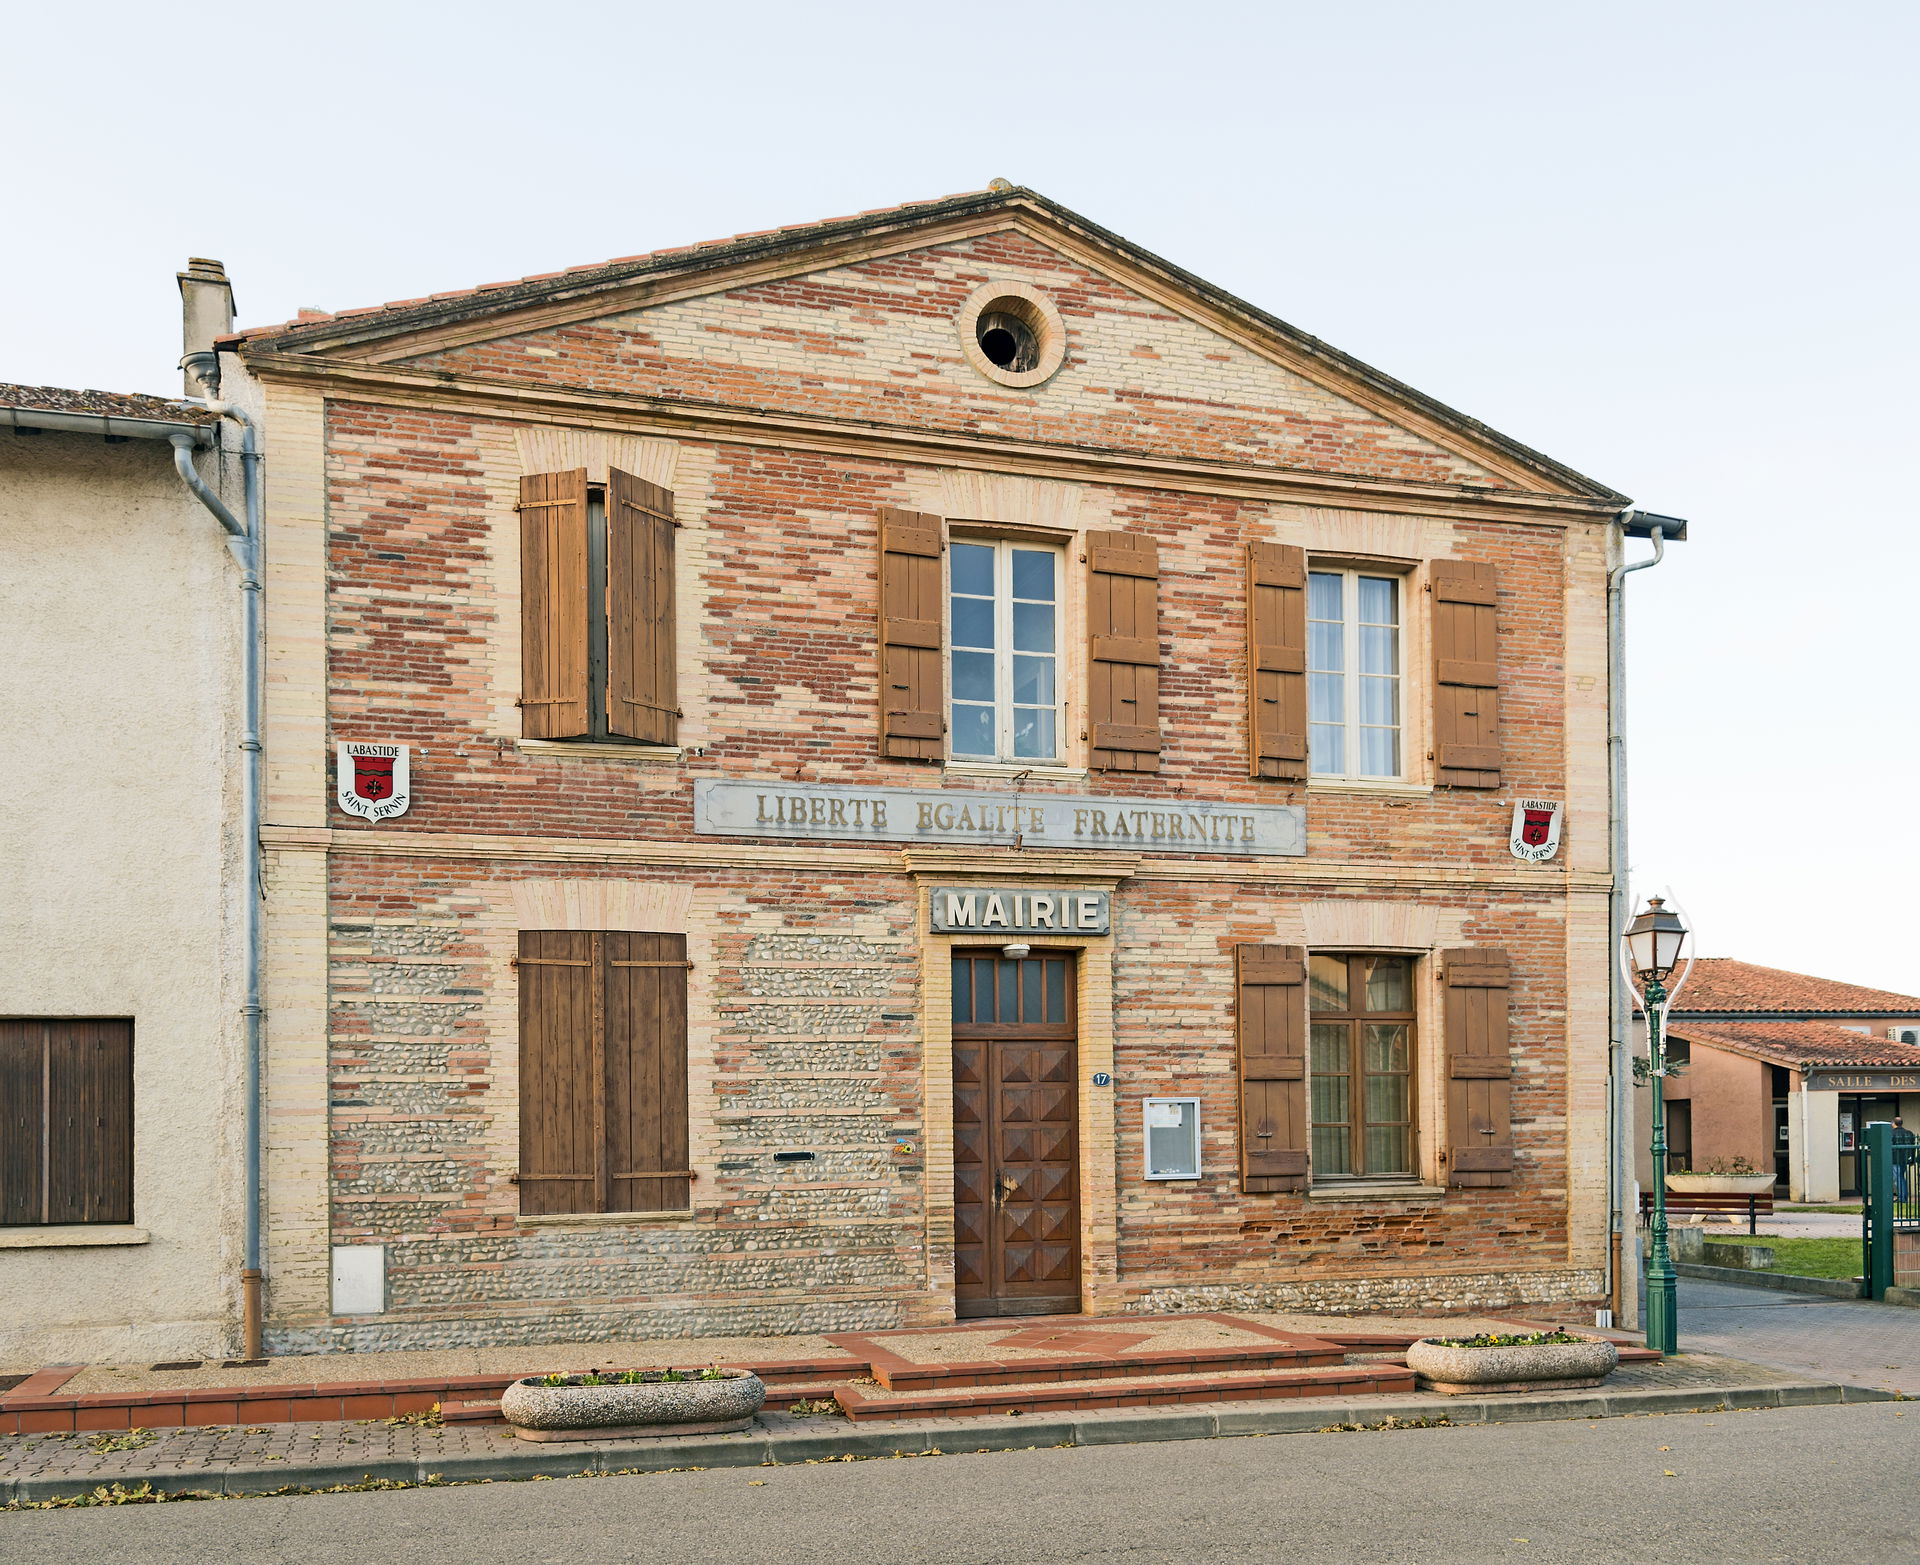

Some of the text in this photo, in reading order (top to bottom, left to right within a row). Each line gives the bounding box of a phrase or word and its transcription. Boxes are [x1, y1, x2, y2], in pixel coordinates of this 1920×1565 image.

[347, 744, 399, 756] LABASTIDE
[341, 790, 406, 817] SAINT SERNIN
[1521, 800, 1558, 811] LABASTIDE
[756, 795, 1256, 842] LIBERTE EGALITE FRATERNITE
[1513, 838, 1556, 860] SAINT SERNIN
[947, 893, 1099, 928] MAIRIE
[1096, 1073, 1107, 1085] 17
[1828, 1075, 1917, 1087] SALLE DES
